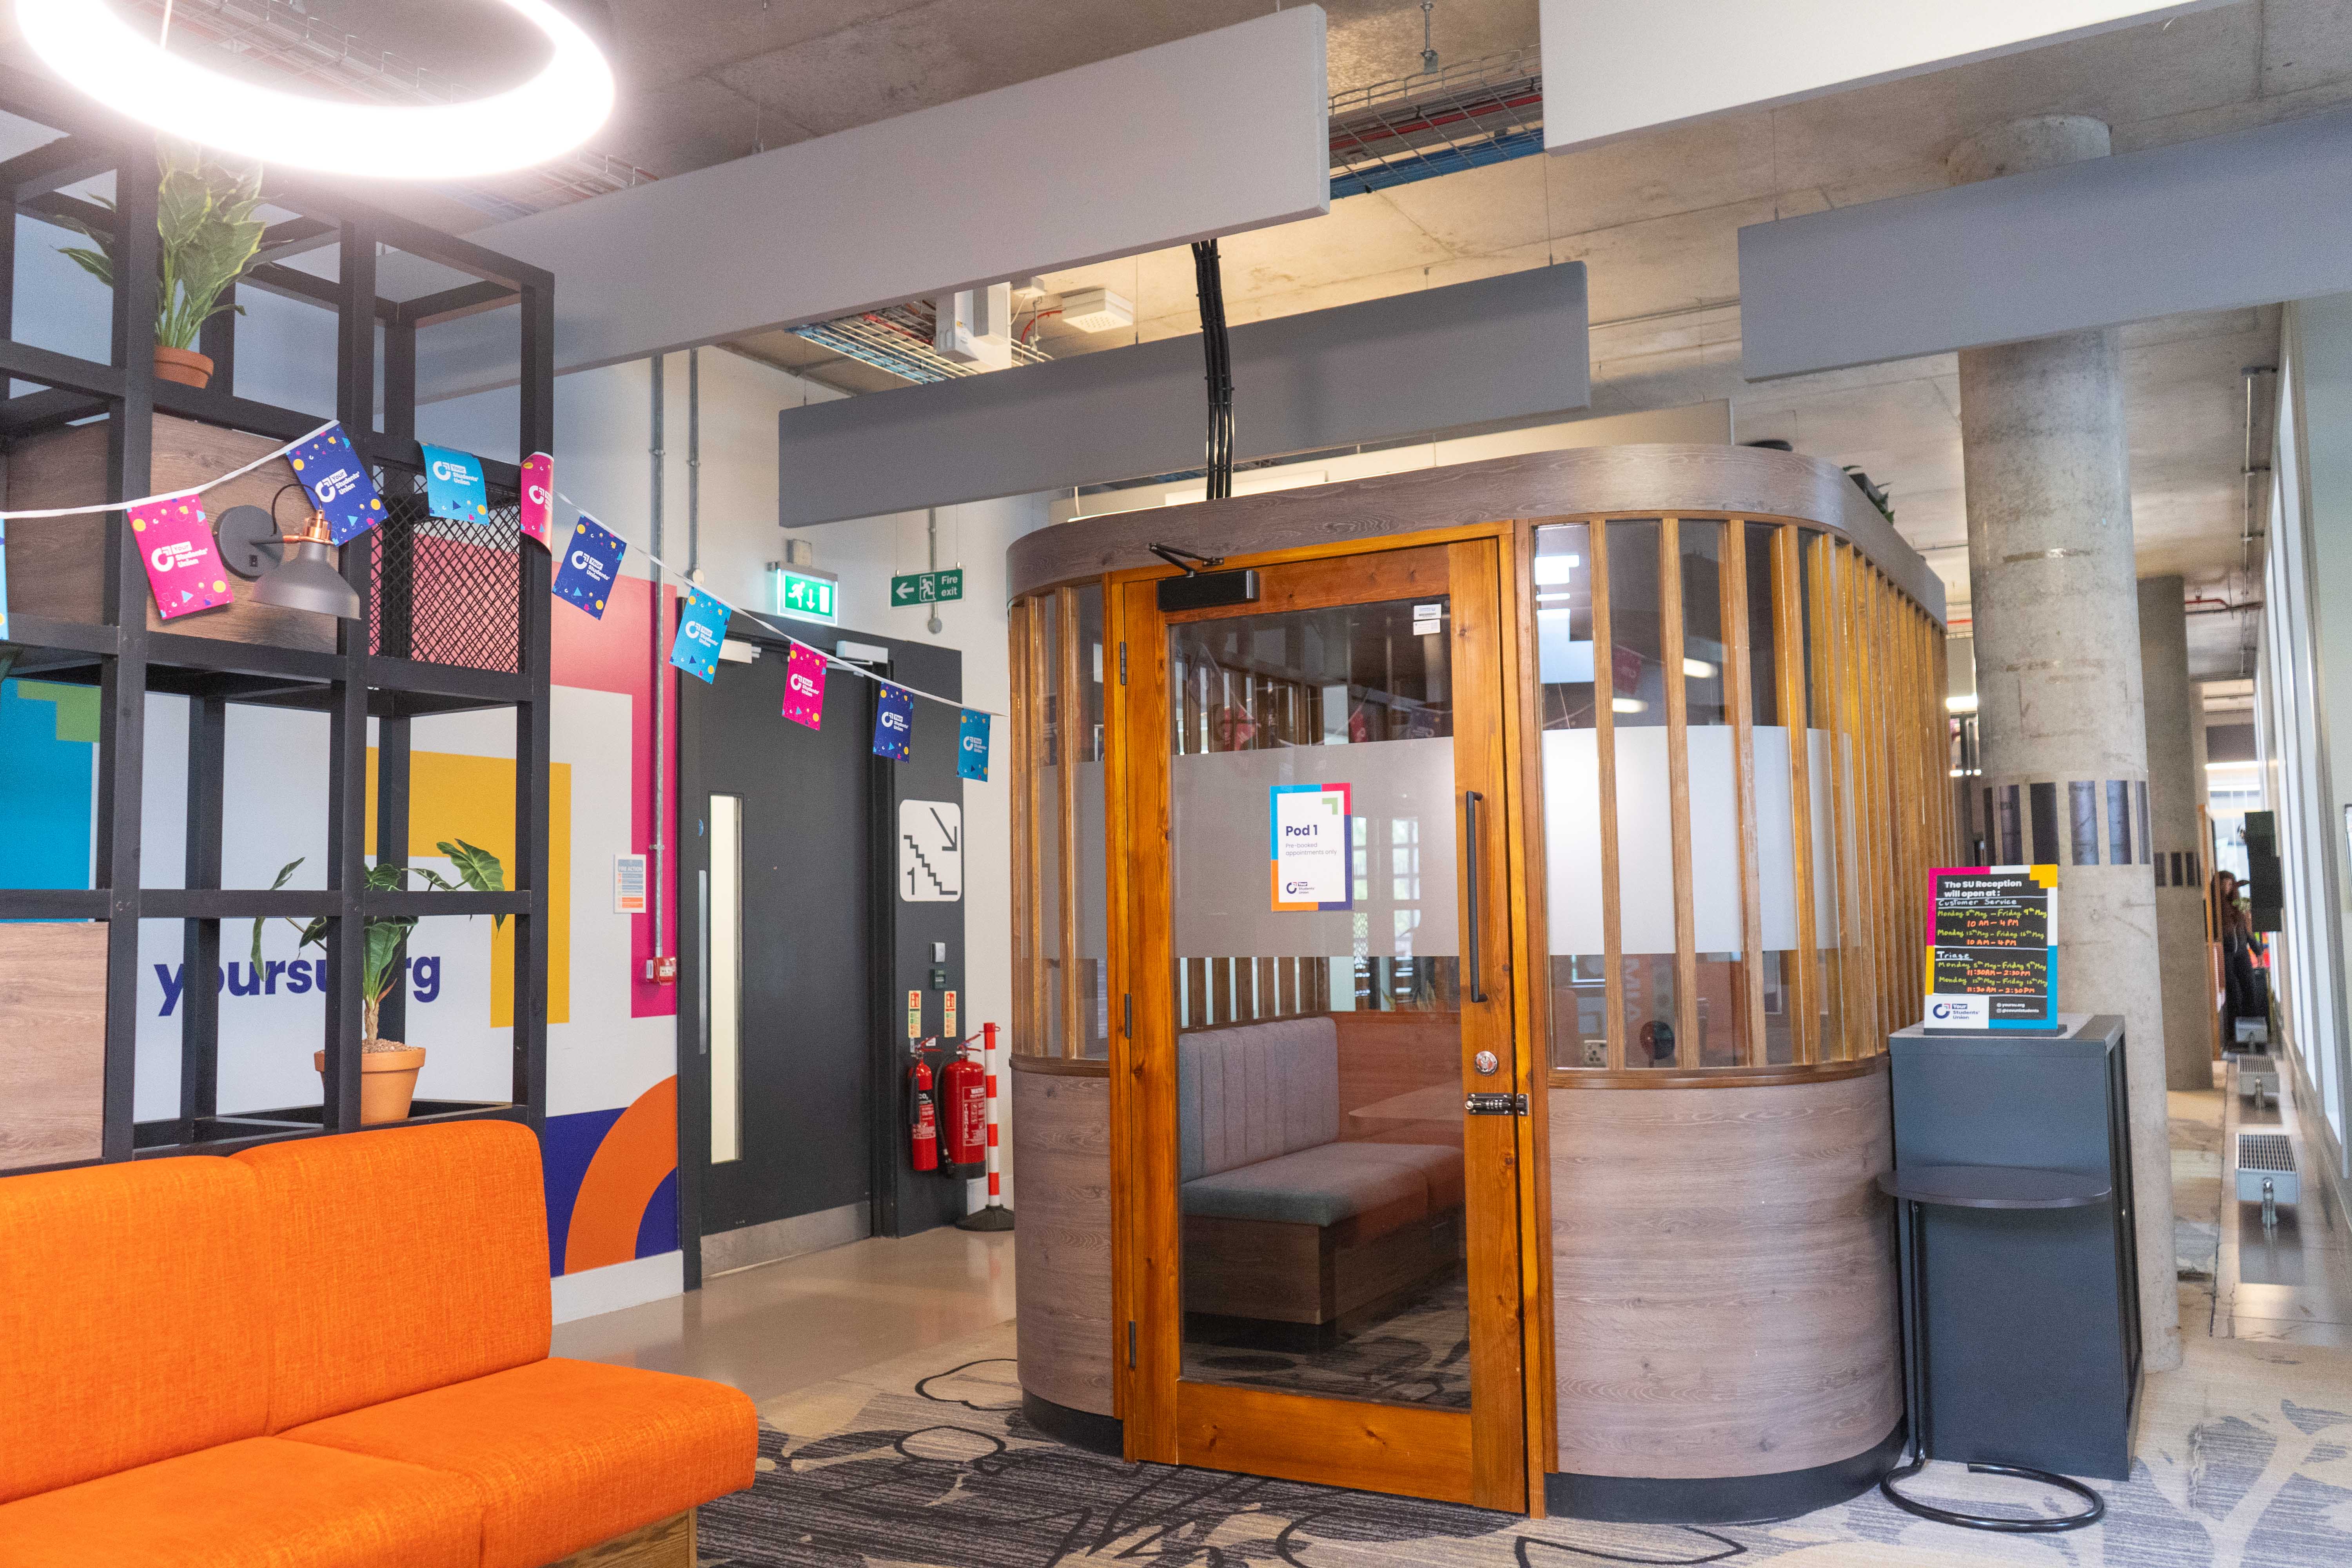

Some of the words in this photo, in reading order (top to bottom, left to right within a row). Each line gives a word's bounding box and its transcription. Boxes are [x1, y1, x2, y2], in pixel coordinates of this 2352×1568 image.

[332, 472, 344, 481] Your
[454, 477, 470, 486] Union
[338, 483, 356, 494] Union
[177, 559, 199, 568] Union
[591, 559, 601, 568] Your
[586, 569, 600, 581] Union
[588, 564, 610, 580] Students'
[942, 575, 958, 584] Fire
[942, 586, 957, 597] exit
[1286, 824, 1310, 836] Pod
[1313, 824, 1318, 835] 1
[907, 867, 915, 895] 1
[1976, 880, 2022, 889] Reception
[1938, 910, 1964, 918] Monday
[1975, 911, 1987, 919] May
[1997, 908, 2022, 919] Friday
[2024, 907, 2034, 915] 9th
[2034, 909, 2047, 918] May
[1937, 929, 1964, 938] Monday
[1977, 930, 1989, 938] May
[1996, 930, 2018, 939] Friday
[2032, 931, 2045, 940] May
[1936, 951, 1970, 960] Triage
[1938, 961, 1971, 969] Monday
[2002, 961, 2024, 971] Friday
[2035, 963, 2046, 971] May
[154, 956, 440, 1017] yursg
[1939, 976, 1967, 985] Monday
[2002, 978, 2024, 987] Friday
